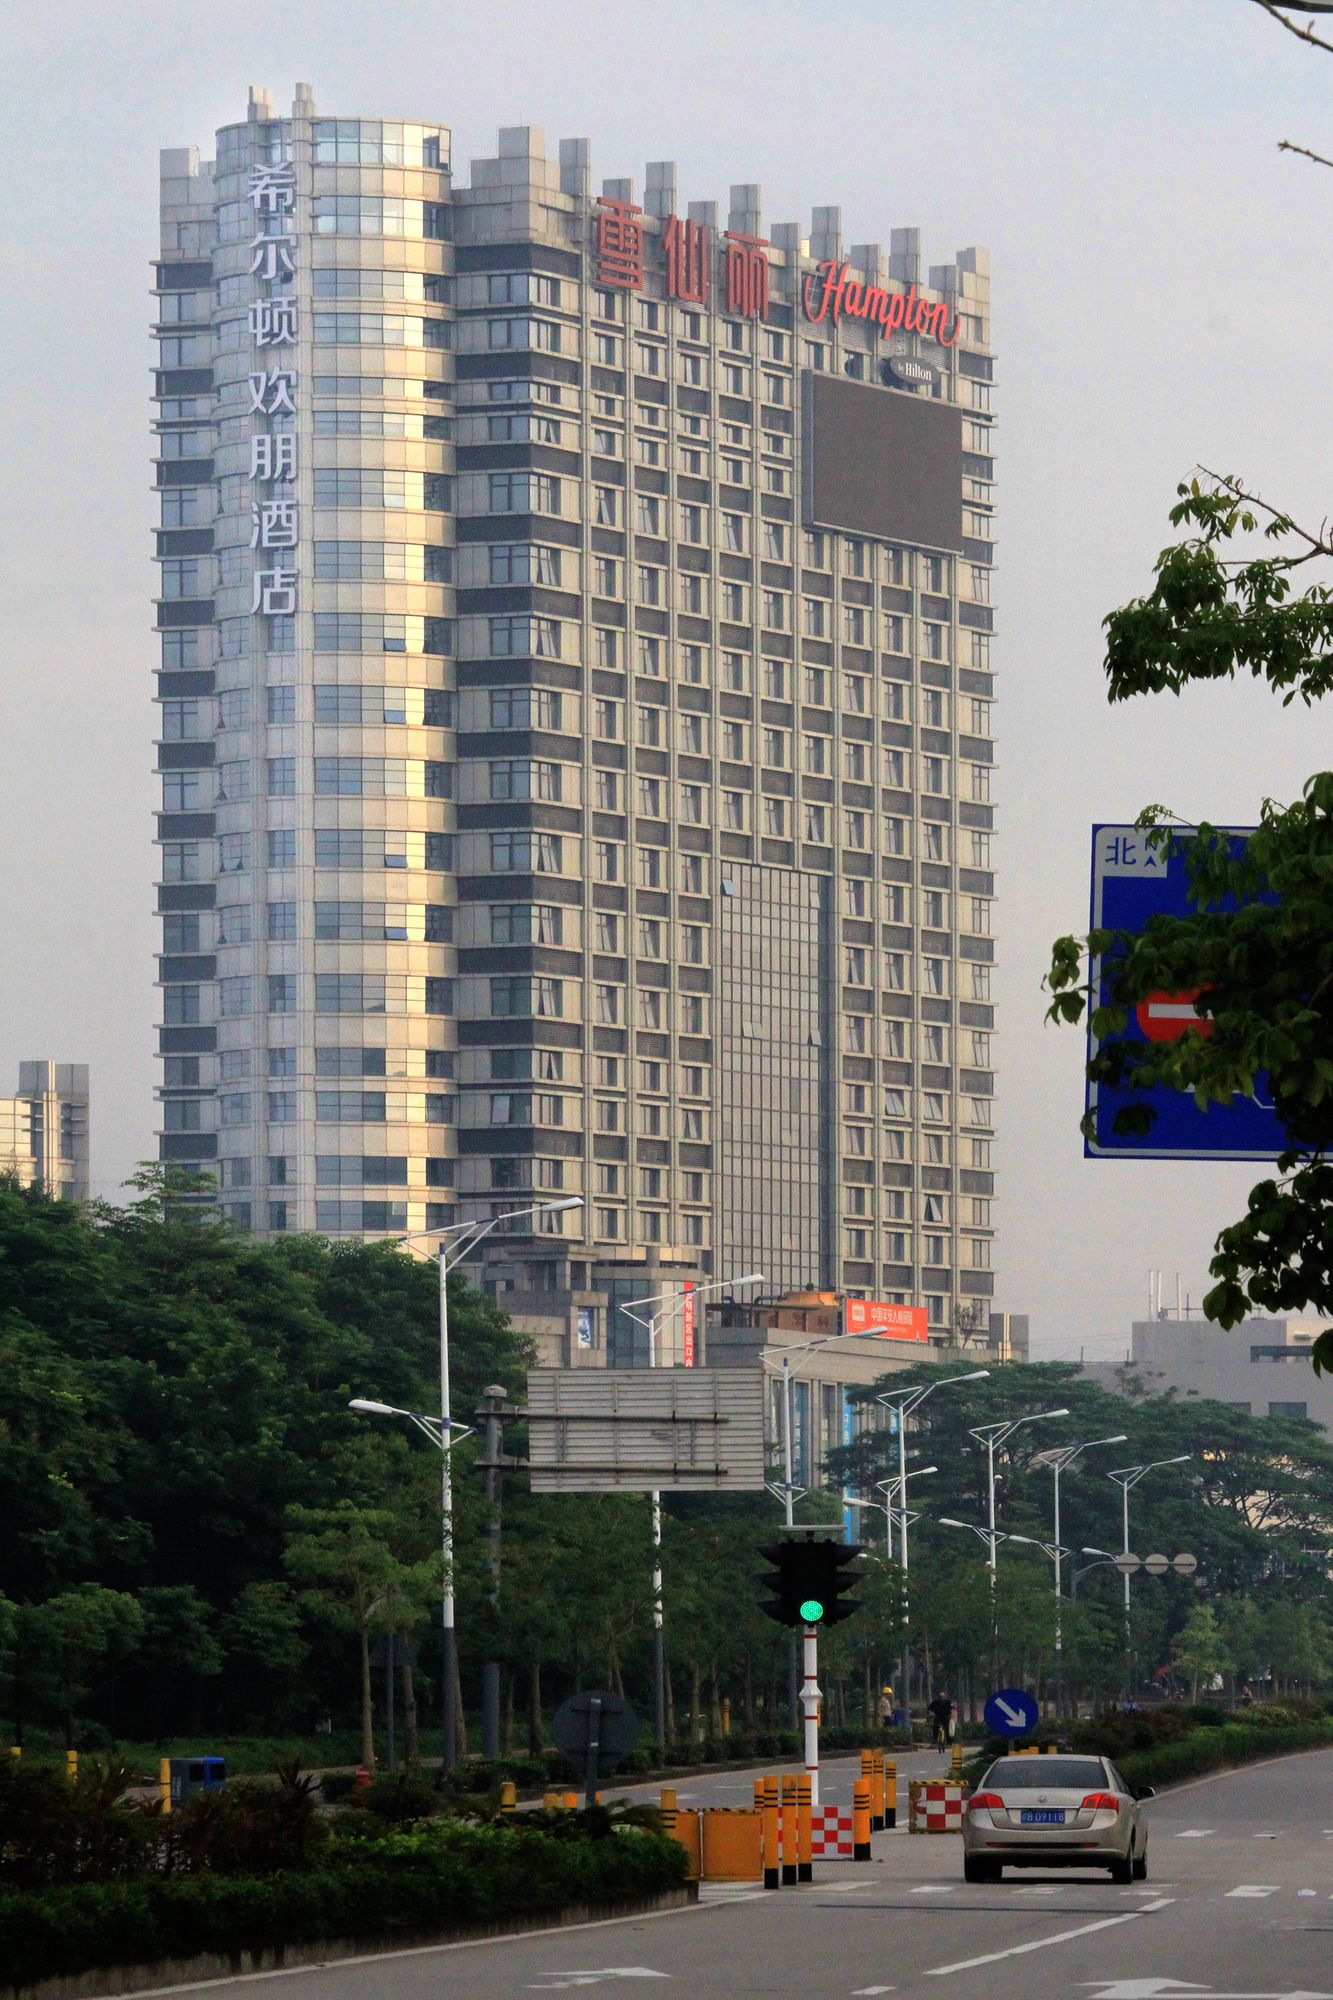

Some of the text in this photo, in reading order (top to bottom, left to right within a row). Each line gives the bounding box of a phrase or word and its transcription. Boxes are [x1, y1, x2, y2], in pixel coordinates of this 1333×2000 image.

[804, 259, 961, 347] Hampton
[247, 162, 299, 617] 希尔顿欢朋酒店
[905, 362, 932, 381] Hilton
[1105, 837, 1136, 865] 北
